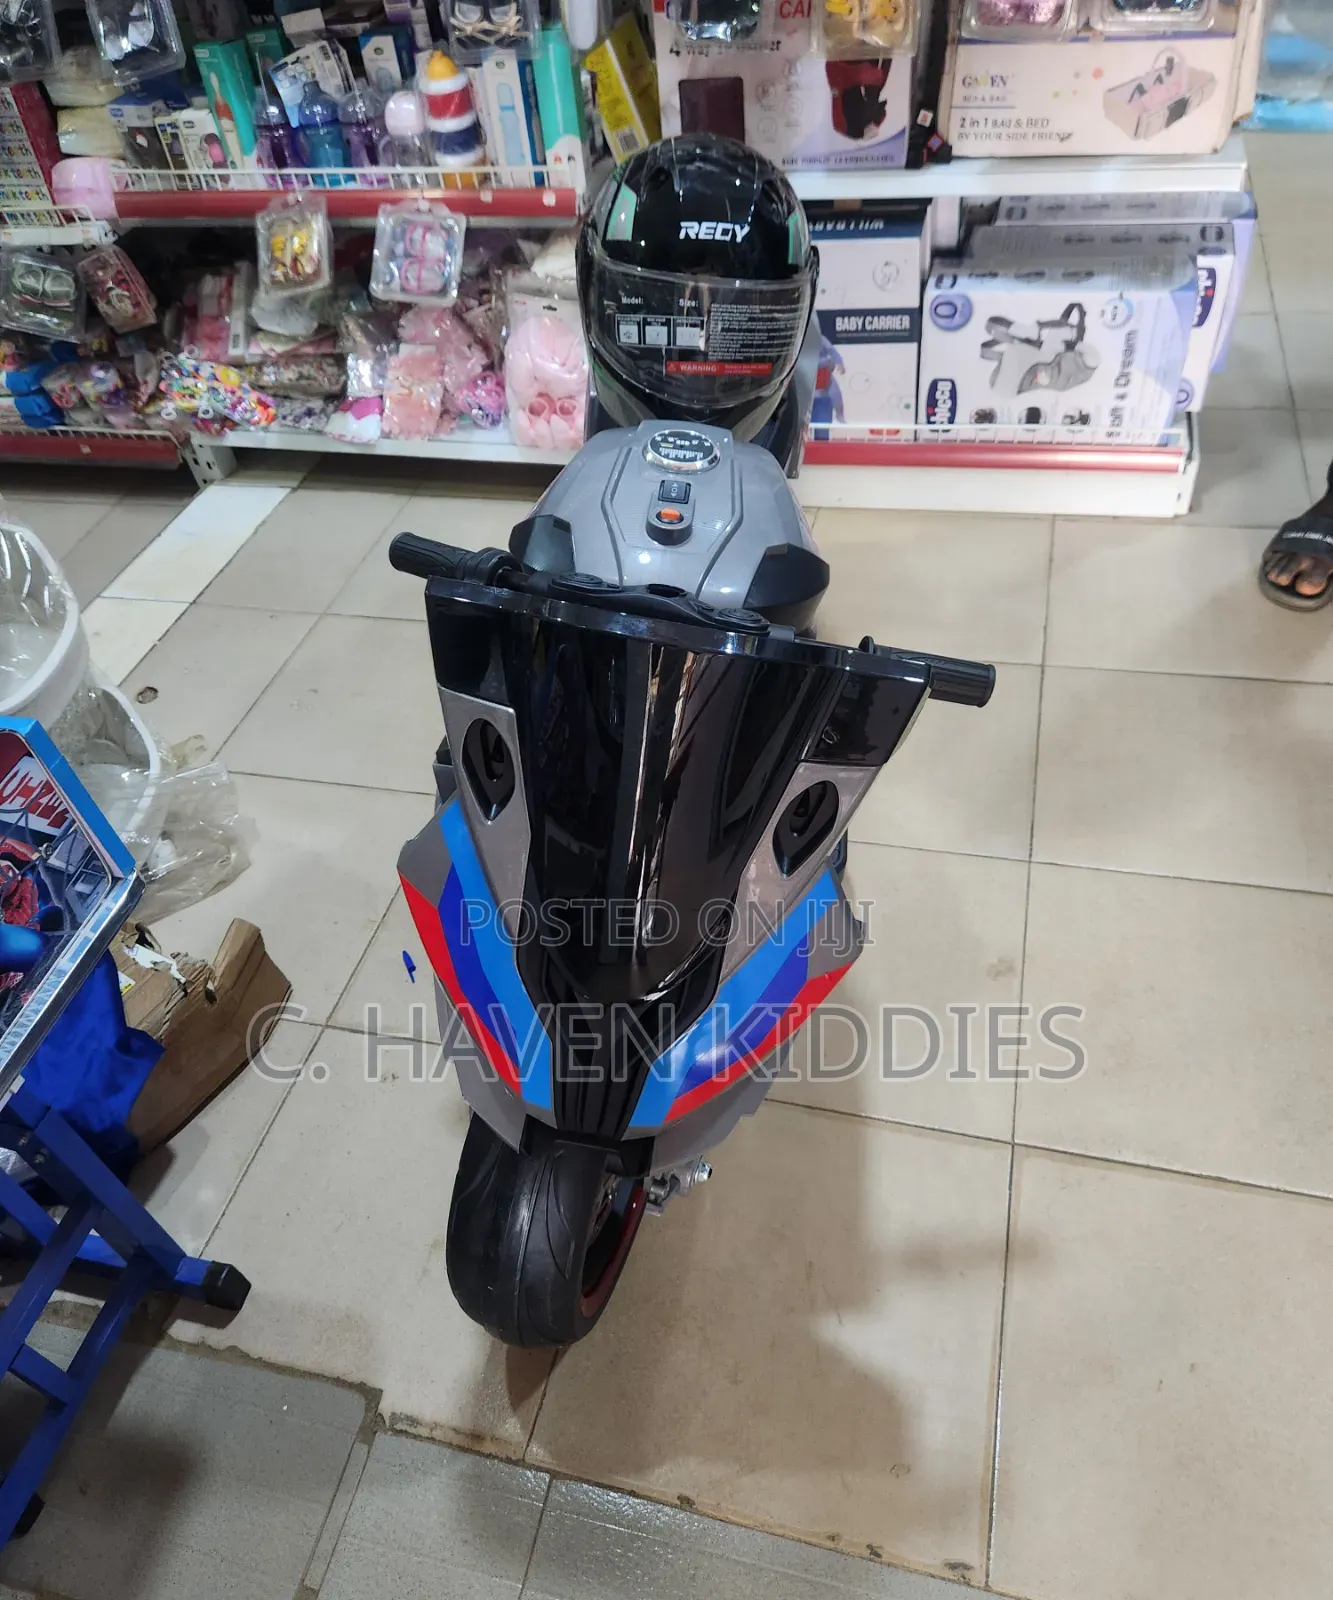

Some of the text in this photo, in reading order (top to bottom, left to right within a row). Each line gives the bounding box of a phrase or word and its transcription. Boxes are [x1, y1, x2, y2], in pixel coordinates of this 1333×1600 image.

[621, 296, 644, 305] Model:
[835, 314, 911, 332] BABY CARRIER
